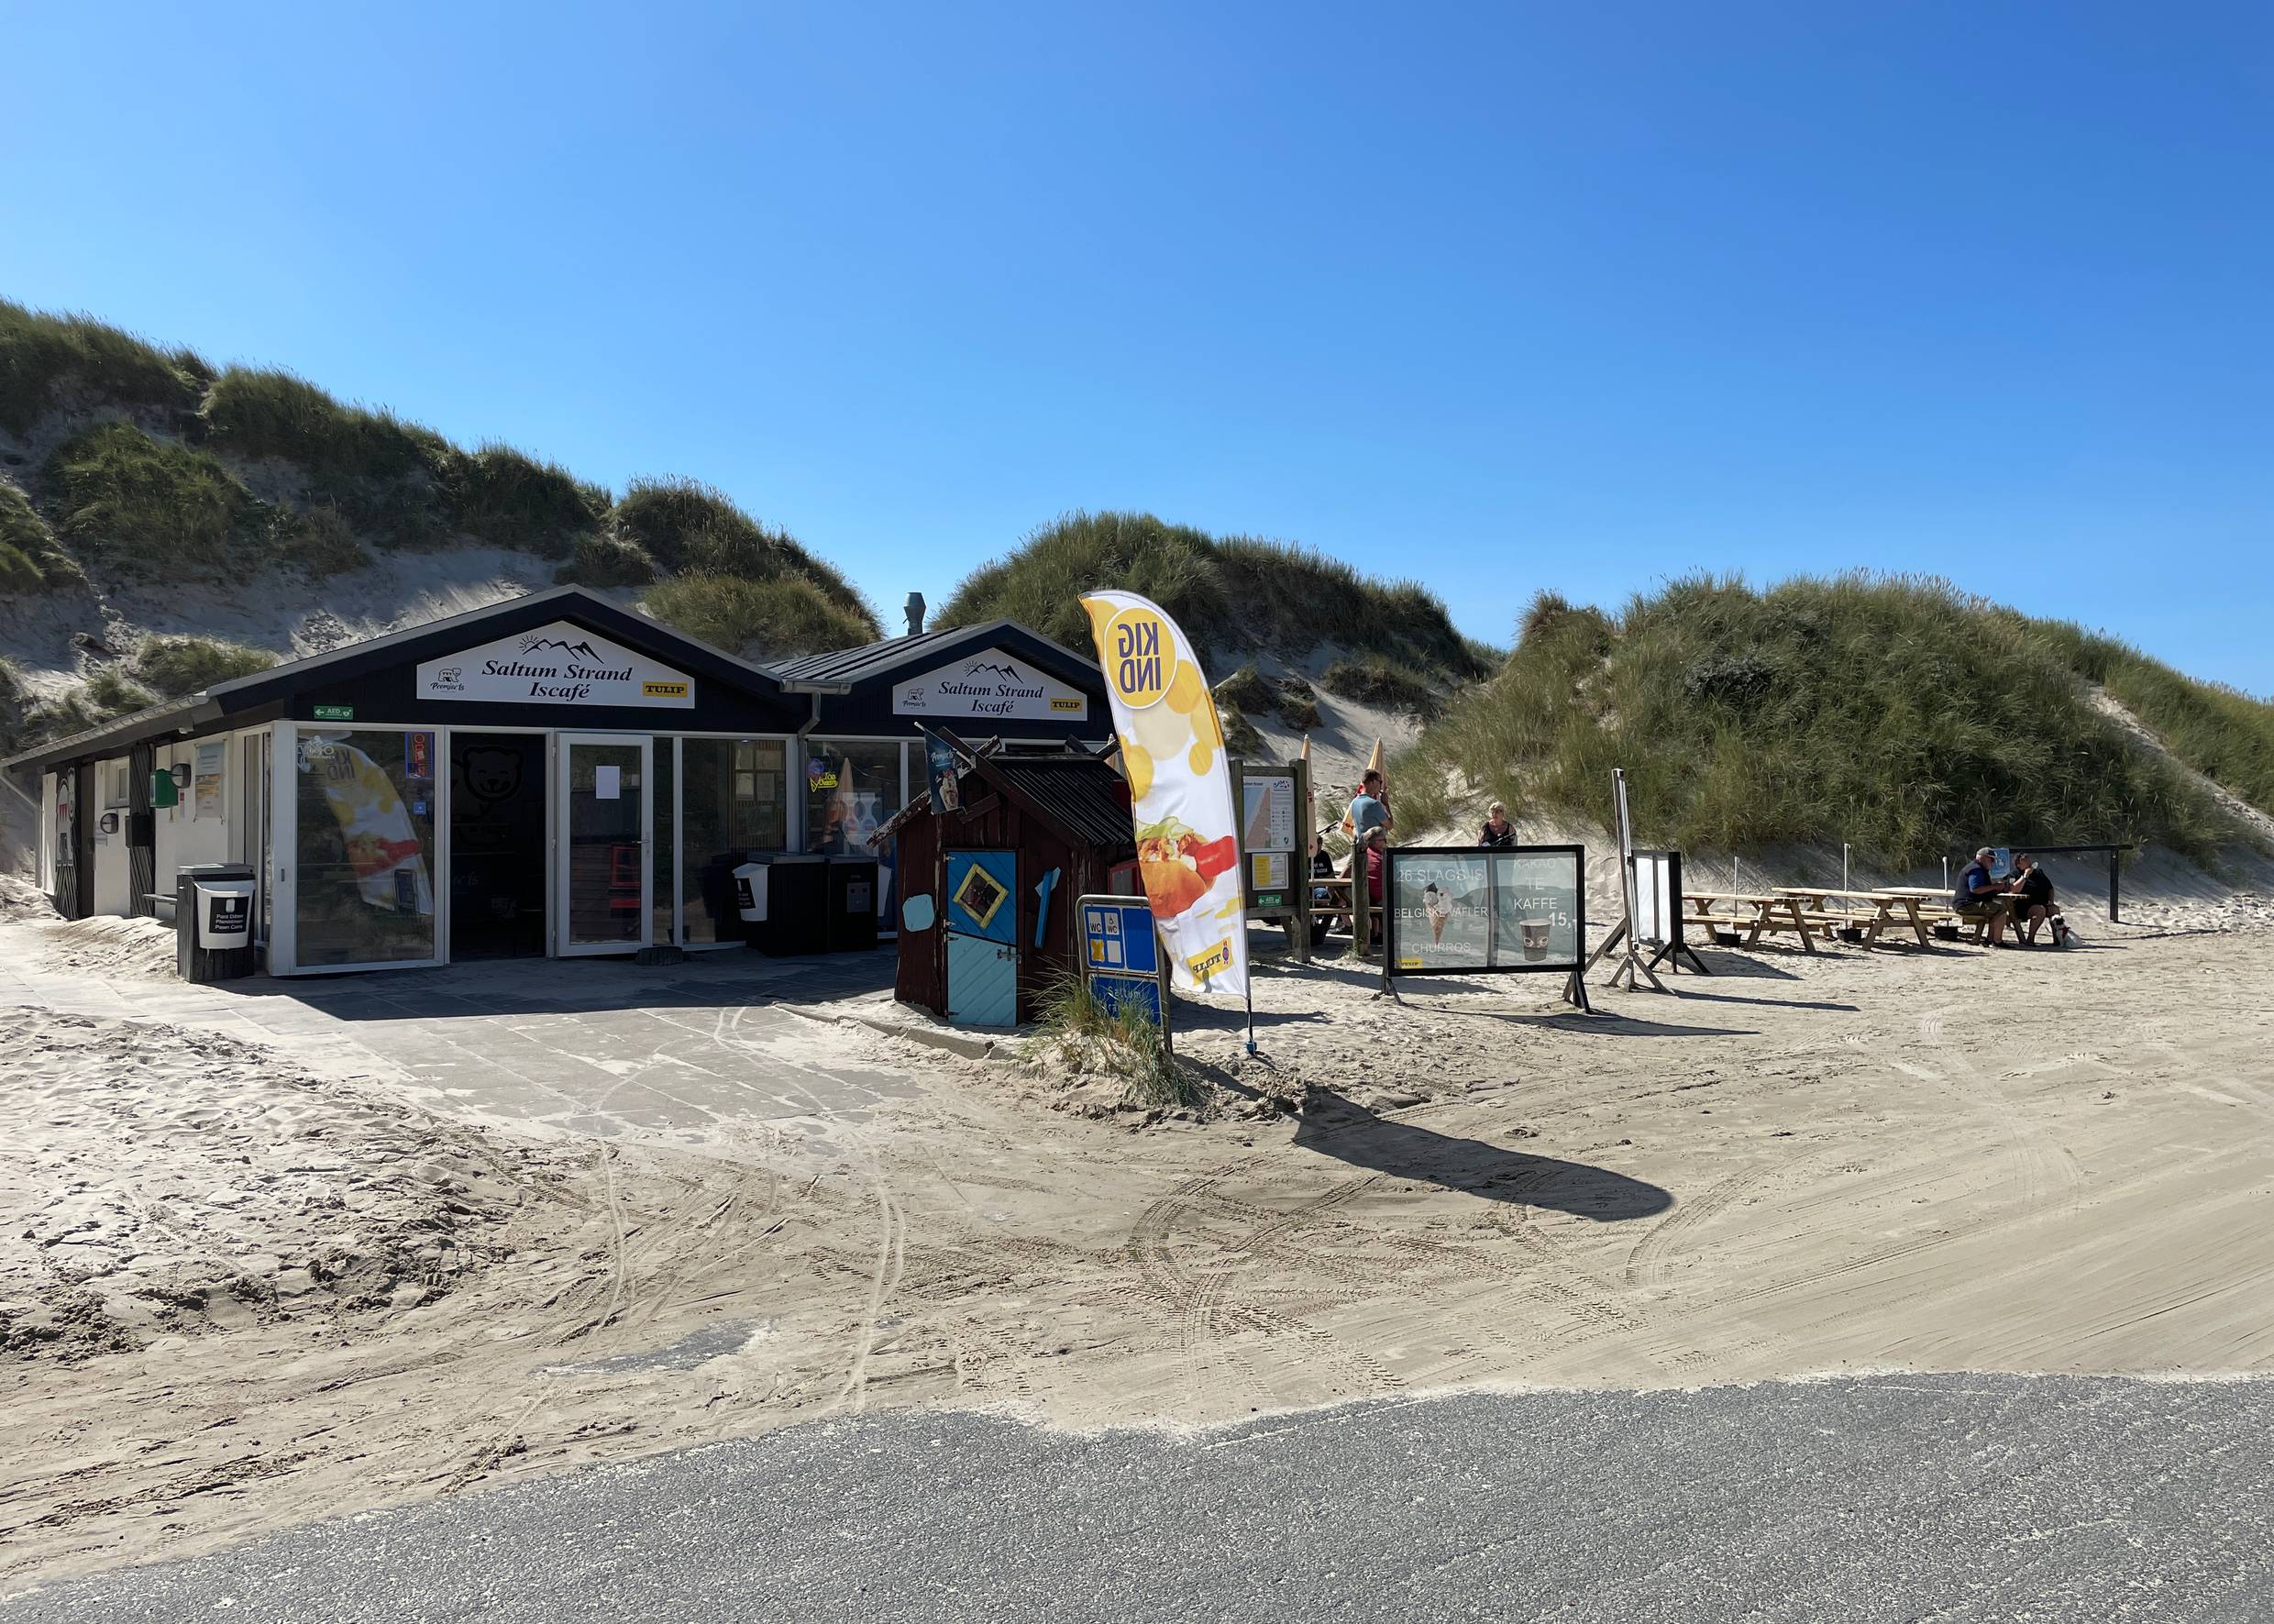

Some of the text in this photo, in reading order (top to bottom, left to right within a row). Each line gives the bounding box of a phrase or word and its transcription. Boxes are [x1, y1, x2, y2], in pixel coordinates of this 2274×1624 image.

[481, 659, 634, 682] Saltum Strand
[528, 681, 591, 702] Iscafé
[645, 685, 685, 694] TULIP
[938, 681, 1044, 699] Saltum Strand
[971, 699, 1014, 714] Iscafé
[1052, 701, 1080, 709] TULIP
[1514, 857, 1556, 869] KAKAO
[1396, 868, 1484, 882] 26 SLAGS IS
[1525, 877, 1545, 890] TE
[1514, 897, 1558, 911] KAFFE
[1394, 906, 1489, 919] BELGISKE VAFLER
[1090, 922, 1102, 933] WC
[1107, 924, 1118, 934] WC
[1411, 942, 1472, 955] CHURROS
